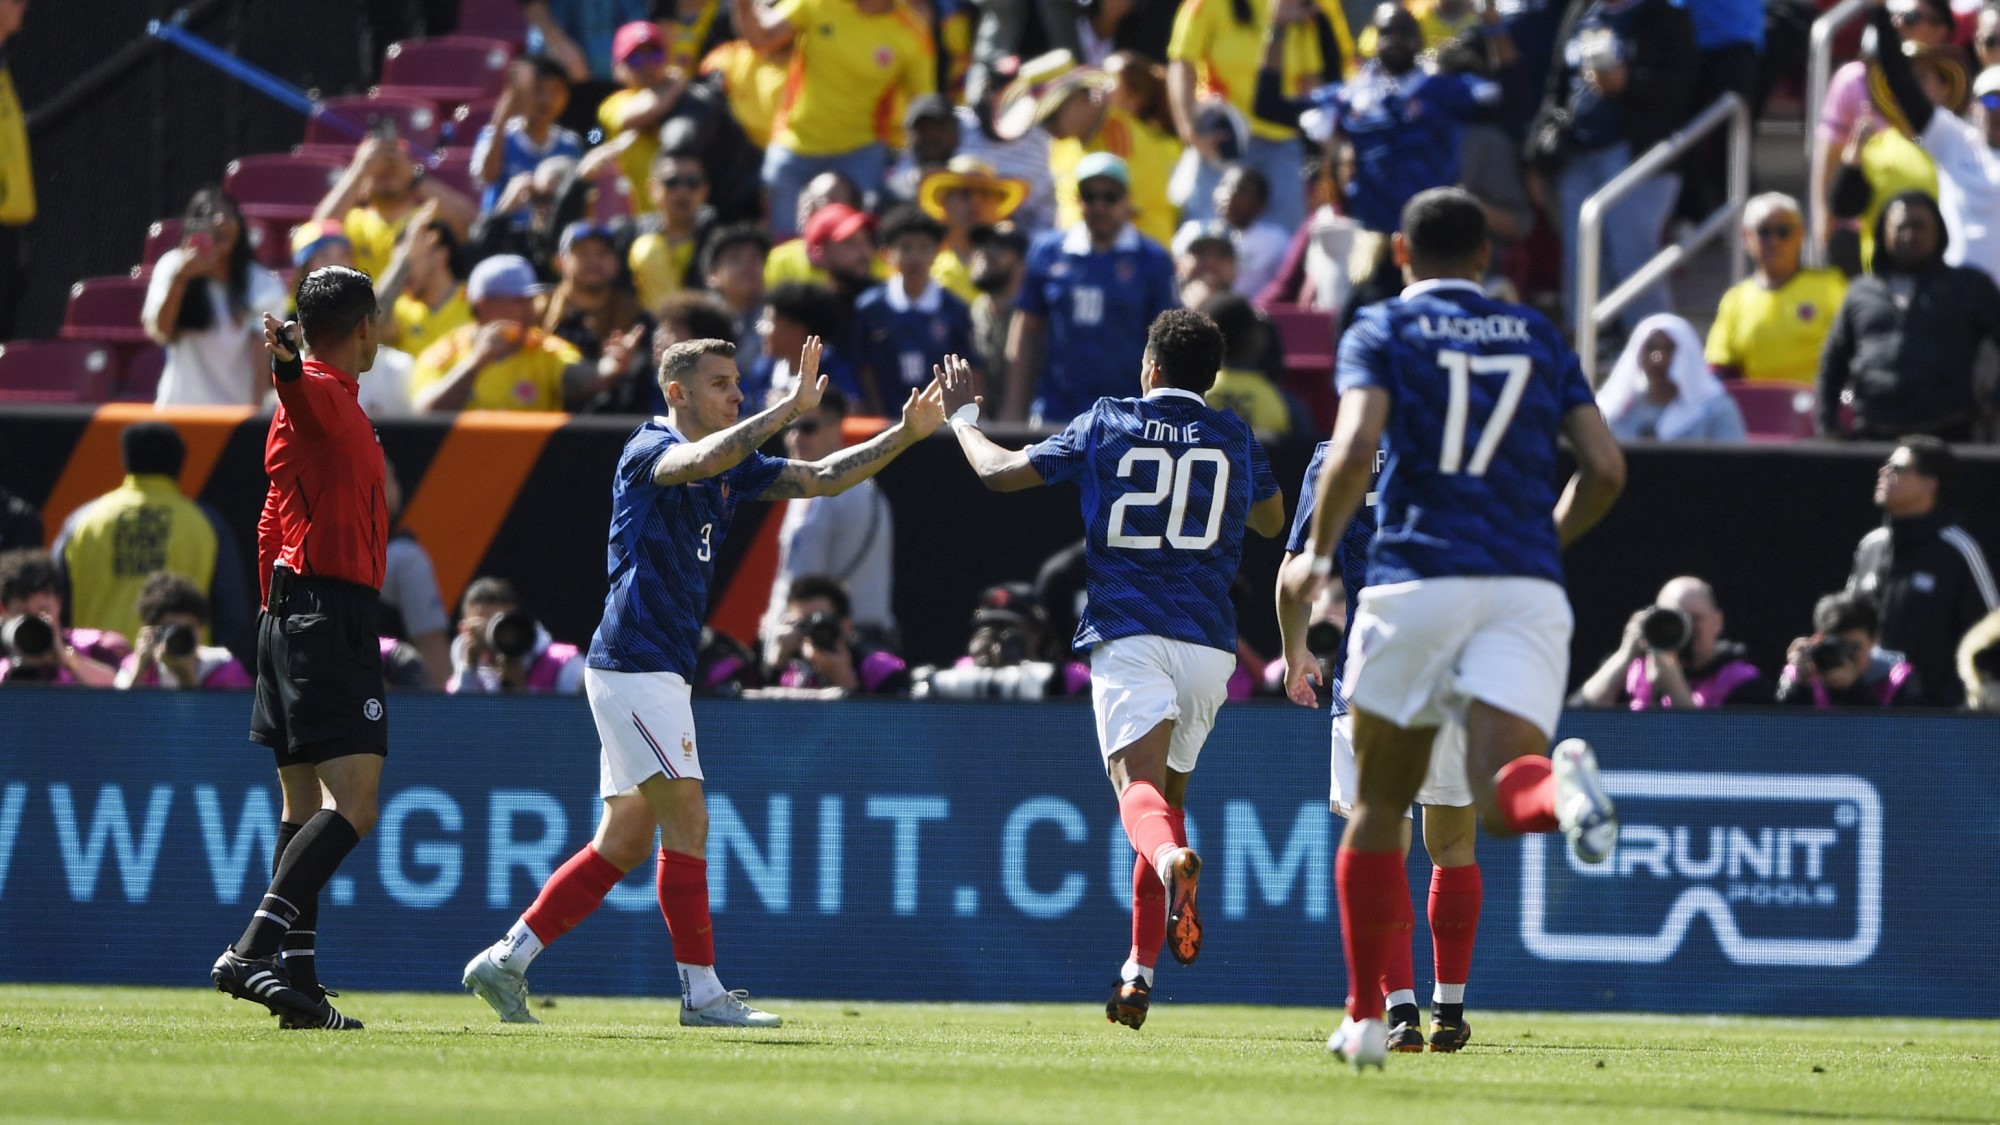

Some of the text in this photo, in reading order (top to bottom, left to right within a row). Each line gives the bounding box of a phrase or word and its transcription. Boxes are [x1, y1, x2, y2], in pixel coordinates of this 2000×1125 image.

[1072, 286, 1104, 326] 10
[1417, 314, 1531, 345] LACROIX
[1437, 349, 1532, 477] 17
[1107, 447, 1230, 550] 20
[696, 523, 713, 562] 3
[0, 783, 1331, 922] WW.GRNIT.CM
